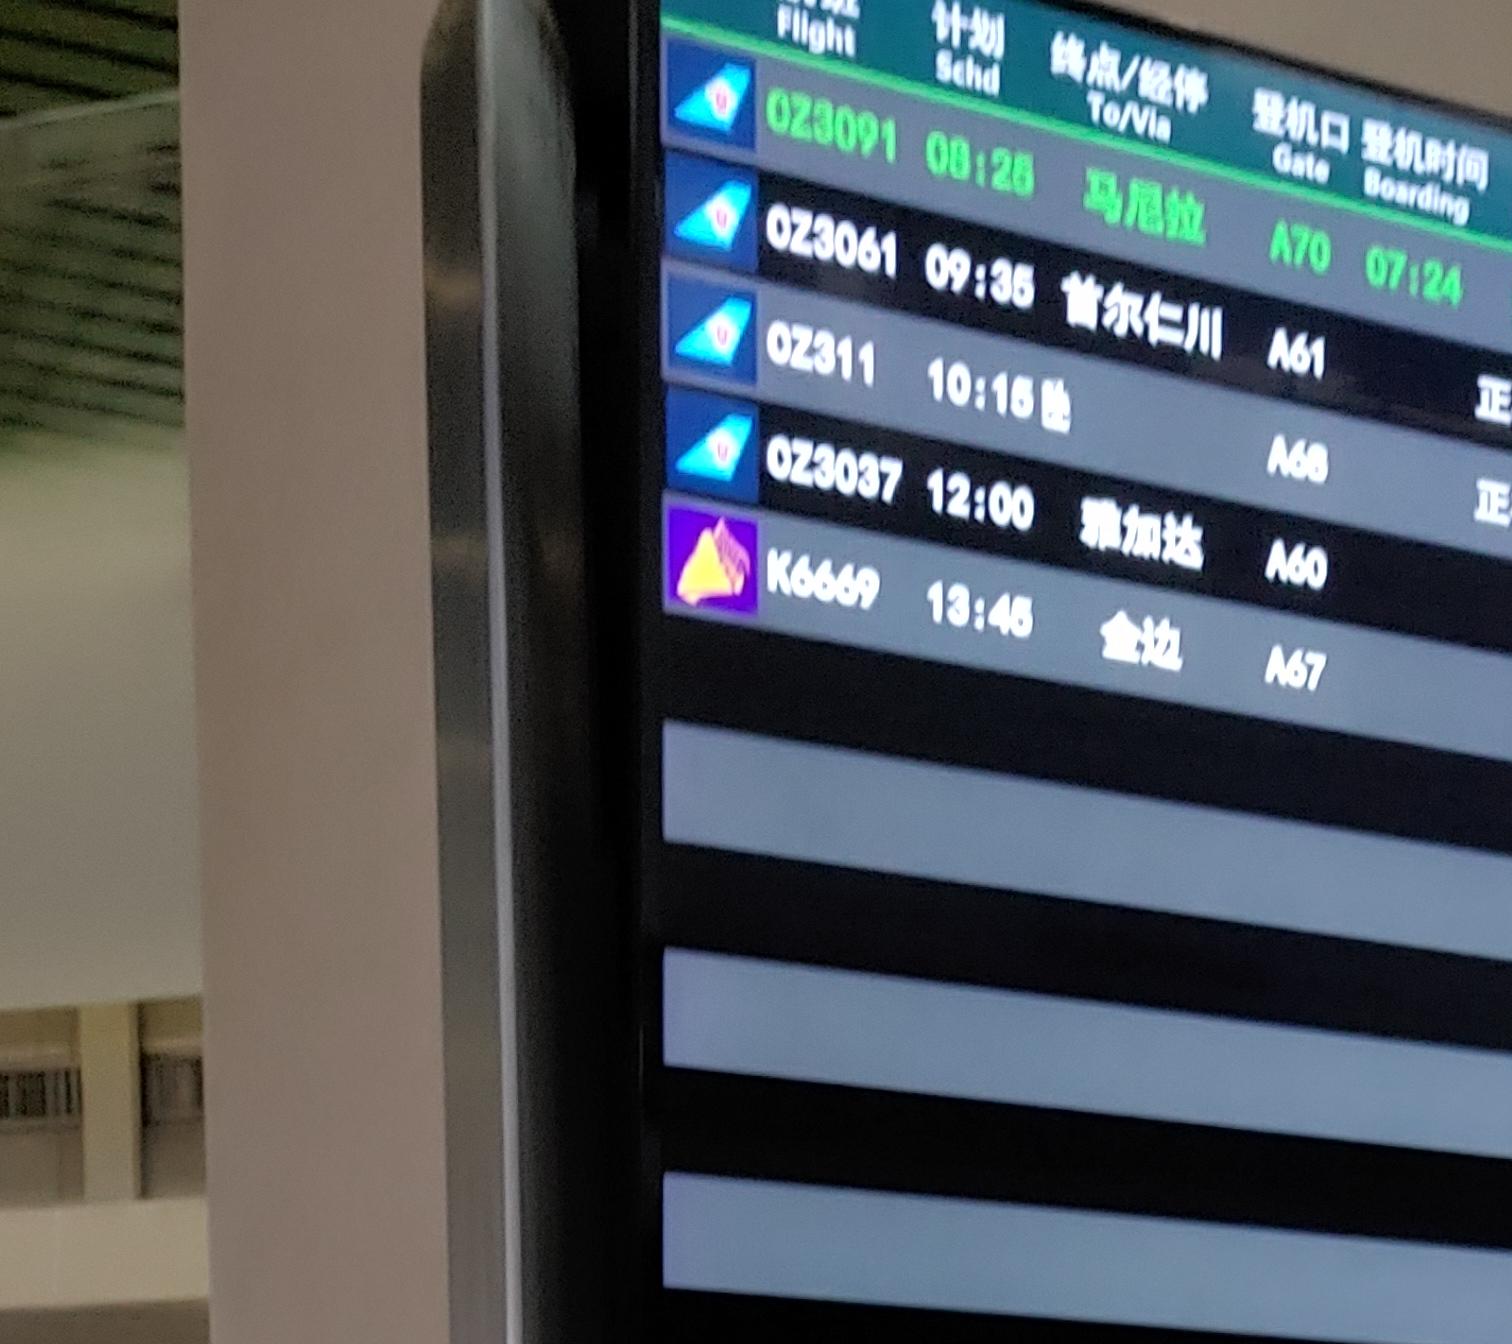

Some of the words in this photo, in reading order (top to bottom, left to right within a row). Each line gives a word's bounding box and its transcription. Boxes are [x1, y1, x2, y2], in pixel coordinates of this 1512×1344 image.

[776, 6, 857, 58] Flight
[935, 48, 1000, 96] Schd
[1086, 88, 1172, 146] To/Via
[1273, 143, 1330, 185] Gate
[1363, 167, 1470, 227] Boarding
[1252, 88, 1350, 154] 登机口
[1269, 219, 1332, 276] A70
[1365, 246, 1464, 308] 07:24
[1266, 326, 1325, 381] A61
[926, 467, 1034, 533] 12:00
[1265, 537, 1328, 591] A60
[766, 546, 881, 610] K6669
[1264, 643, 1327, 692] A67
